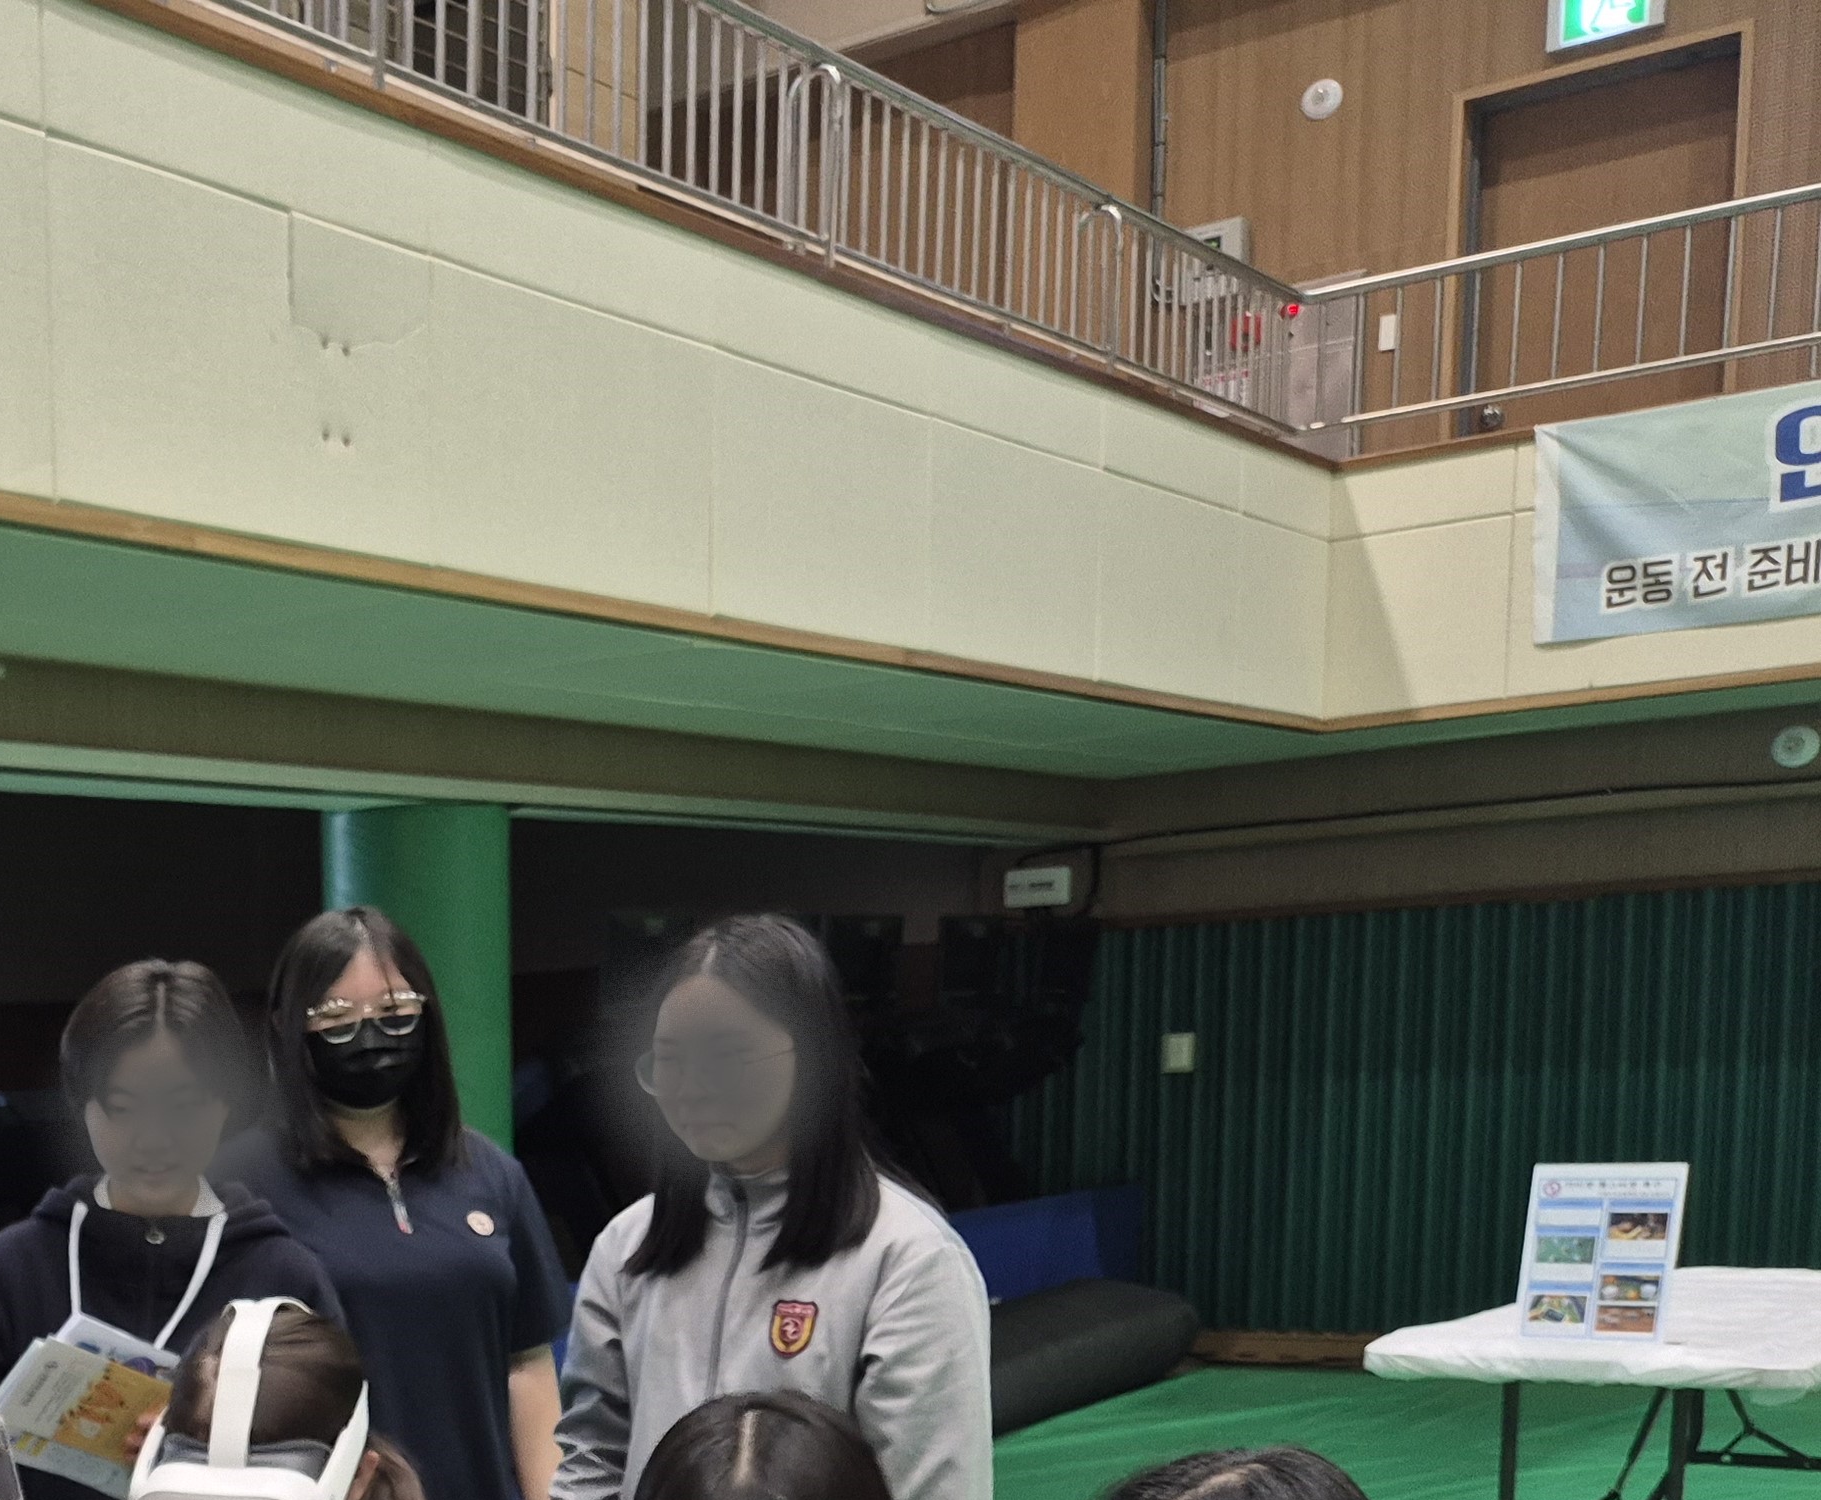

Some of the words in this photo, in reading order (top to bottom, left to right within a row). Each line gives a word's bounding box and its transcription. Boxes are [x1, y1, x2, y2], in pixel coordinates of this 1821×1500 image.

[1606, 559, 1673, 609] 운동
[1693, 552, 1729, 599] 전
[1747, 539, 1821, 593] 준비
